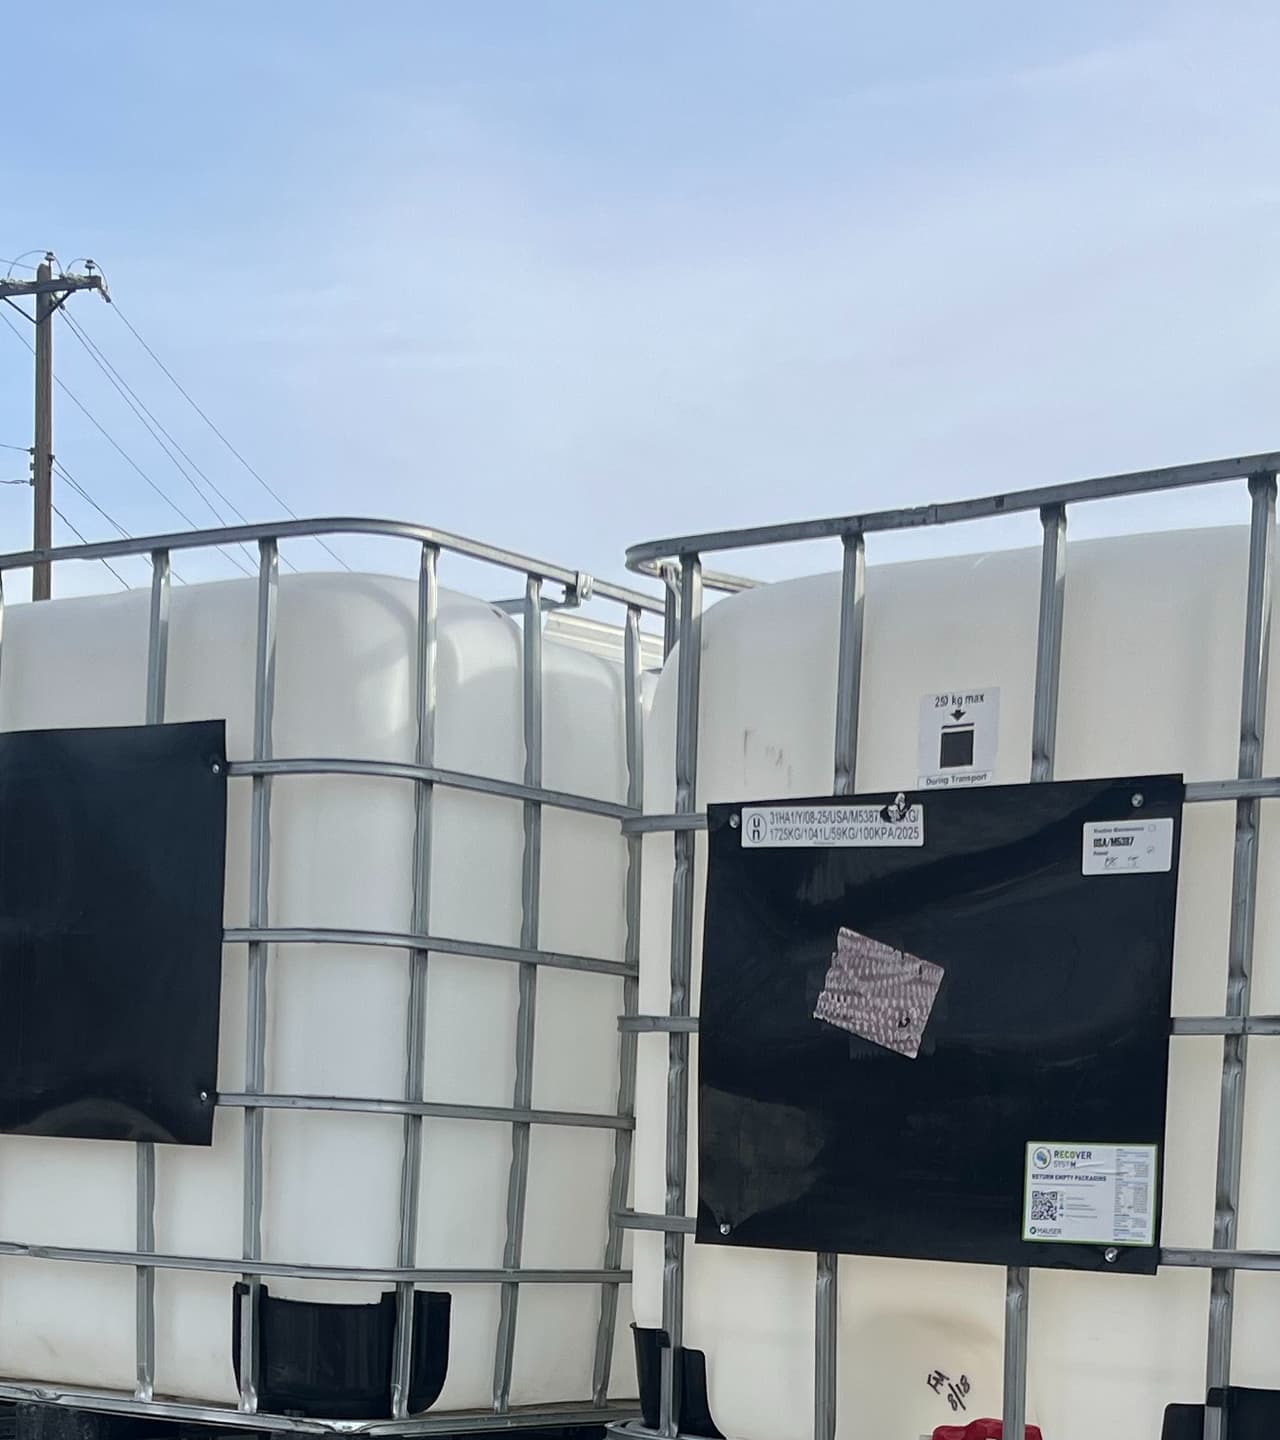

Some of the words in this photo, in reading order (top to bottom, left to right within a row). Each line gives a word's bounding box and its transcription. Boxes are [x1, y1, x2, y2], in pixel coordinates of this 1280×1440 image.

[952, 696, 962, 708] kg
[965, 694, 984, 704] max
[1054, 1150, 1092, 1160] RECOVER
[1054, 1160, 1076, 1168] SYSTM
[948, 1375, 970, 1411] 8/18
